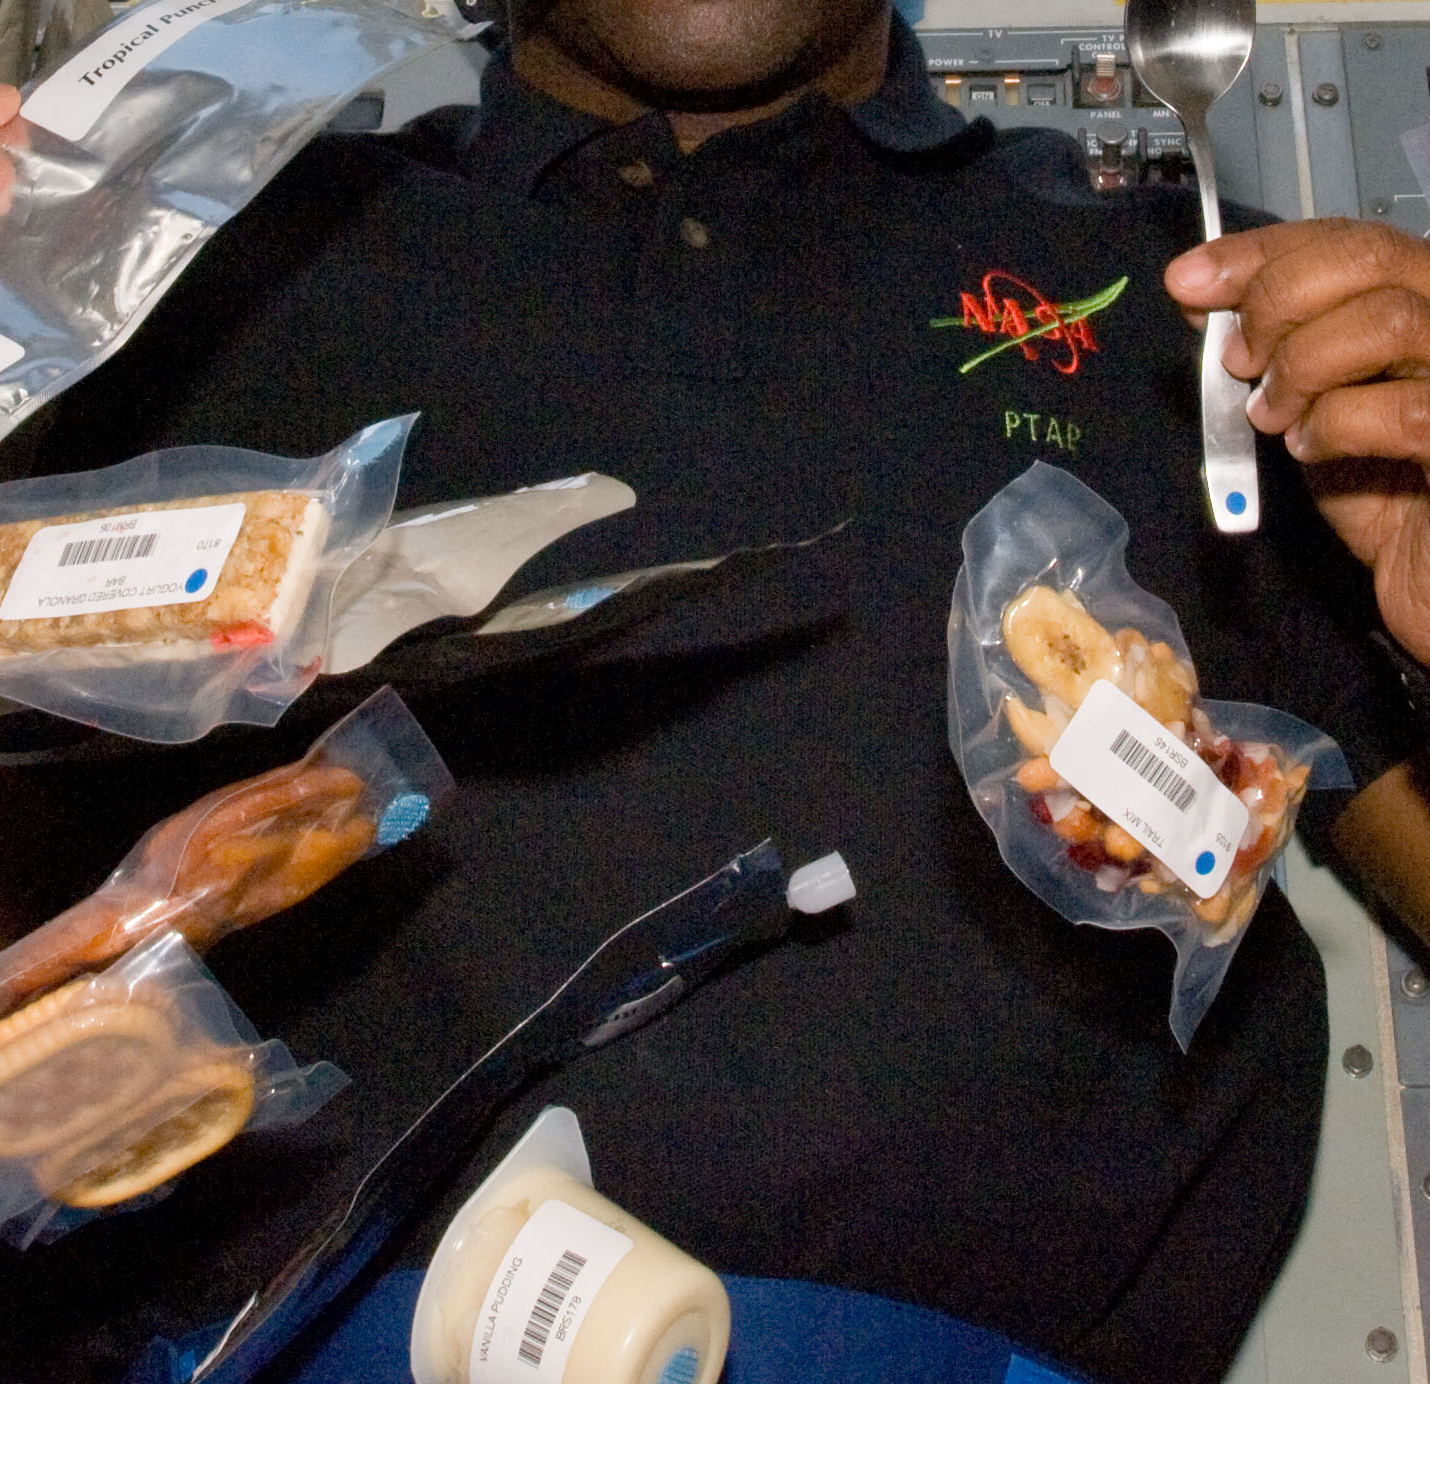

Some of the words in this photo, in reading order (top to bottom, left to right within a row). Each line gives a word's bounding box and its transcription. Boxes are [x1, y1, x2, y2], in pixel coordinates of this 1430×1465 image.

[988, 30, 1003, 38] TV
[78, 23, 160, 90] Tropical
[929, 58, 964, 66] POWER
[1090, 111, 1121, 119] PANEL
[958, 291, 1100, 354] NASA
[1004, 411, 1082, 453] PTAP
[105, 575, 126, 587] BAR
[87, 587, 138, 602] COVERED
[140, 582, 184, 596] YOGURT
[38, 594, 85, 608] GRANOLA
[1122, 807, 1142, 827] MIX
[1137, 818, 1167, 850] TRAIL
[477, 1312, 498, 1362] VANILLA
[492, 1256, 524, 1315] PUDDING
